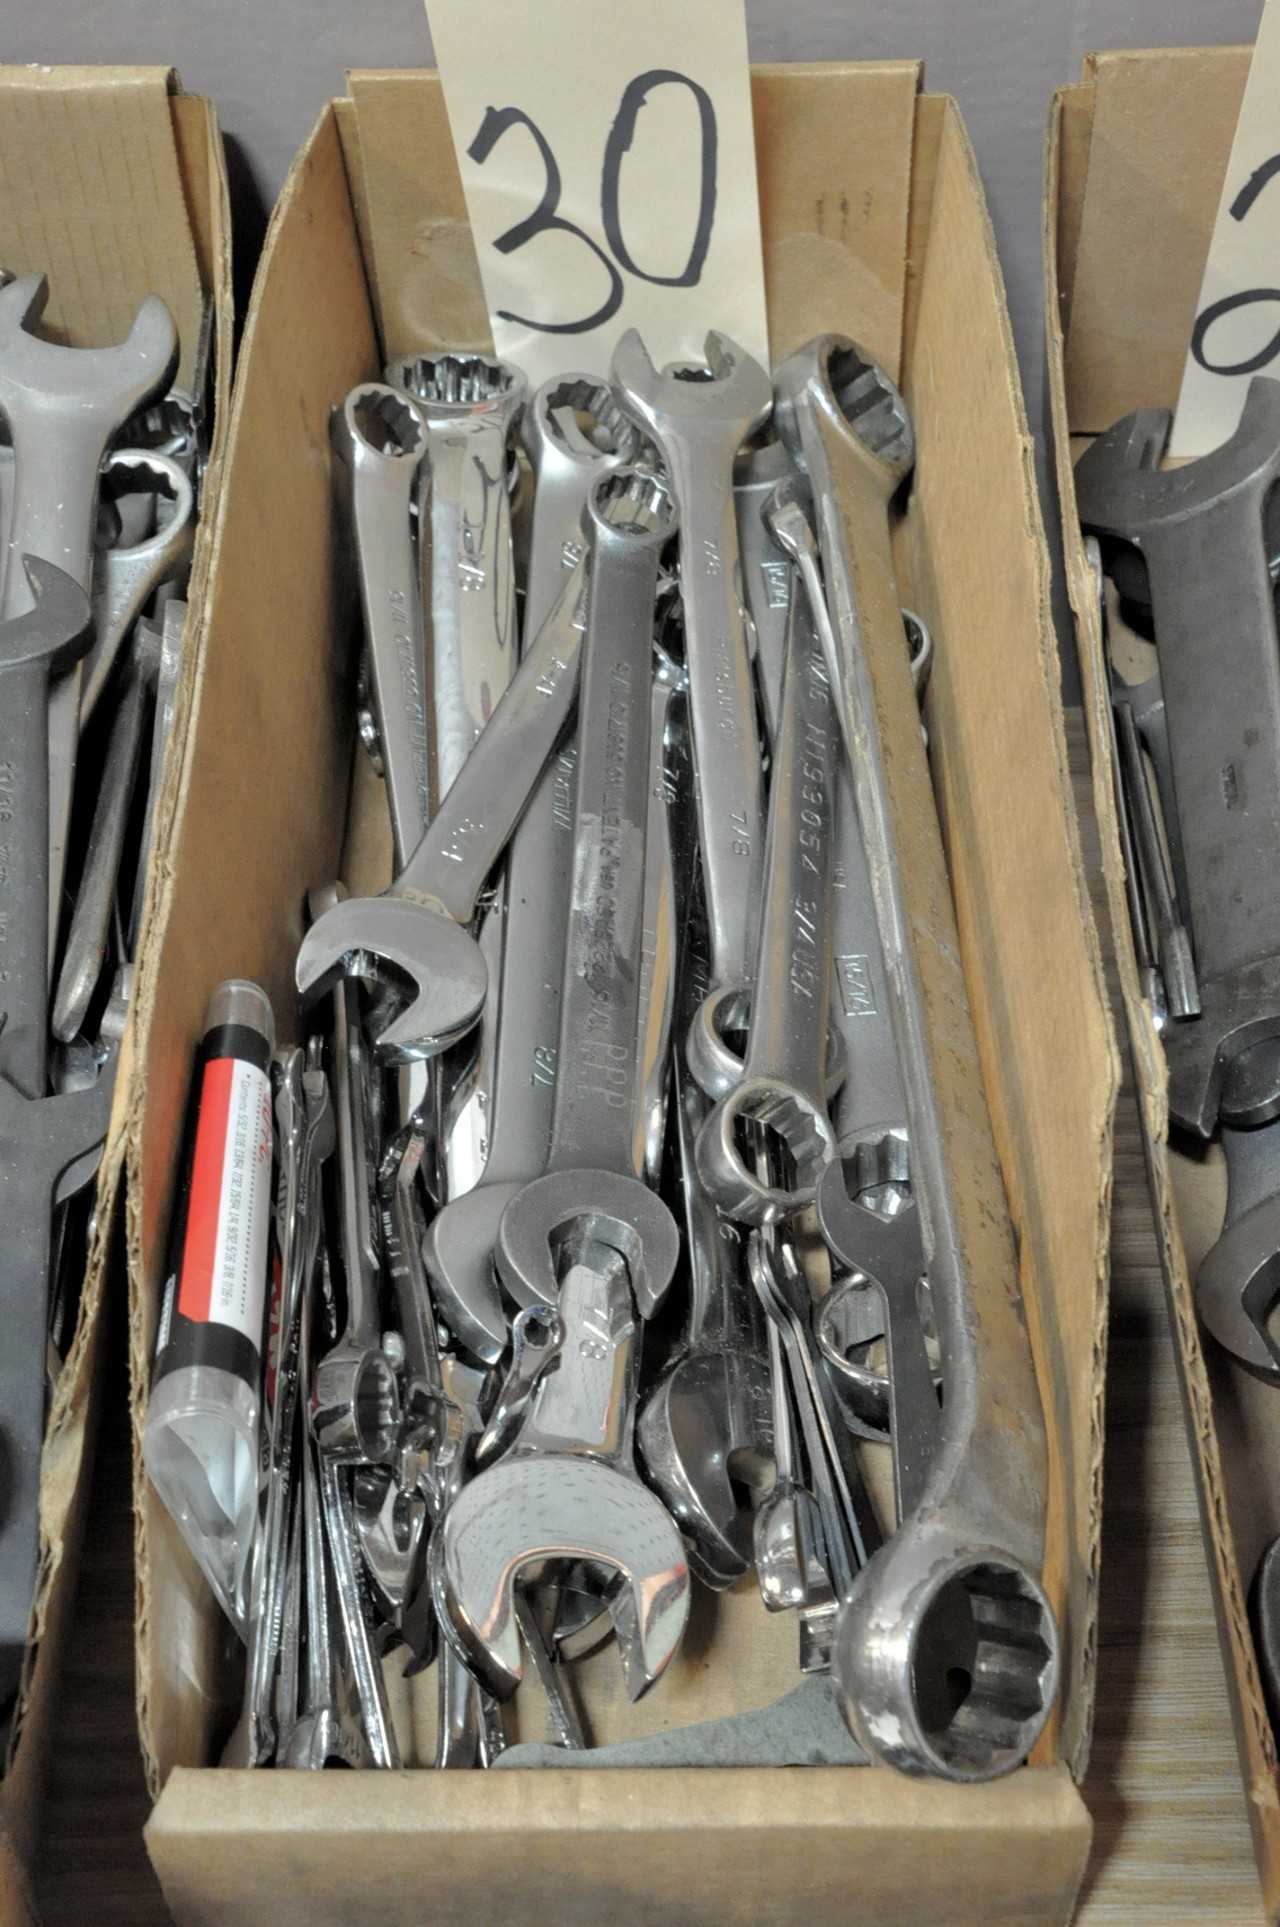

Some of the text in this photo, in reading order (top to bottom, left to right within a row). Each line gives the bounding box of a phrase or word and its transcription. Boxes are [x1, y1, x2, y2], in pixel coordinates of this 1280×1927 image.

[467, 69, 717, 334] 30
[729, 811, 751, 857] 7/8
[530, 1045, 557, 1088] 7/8
